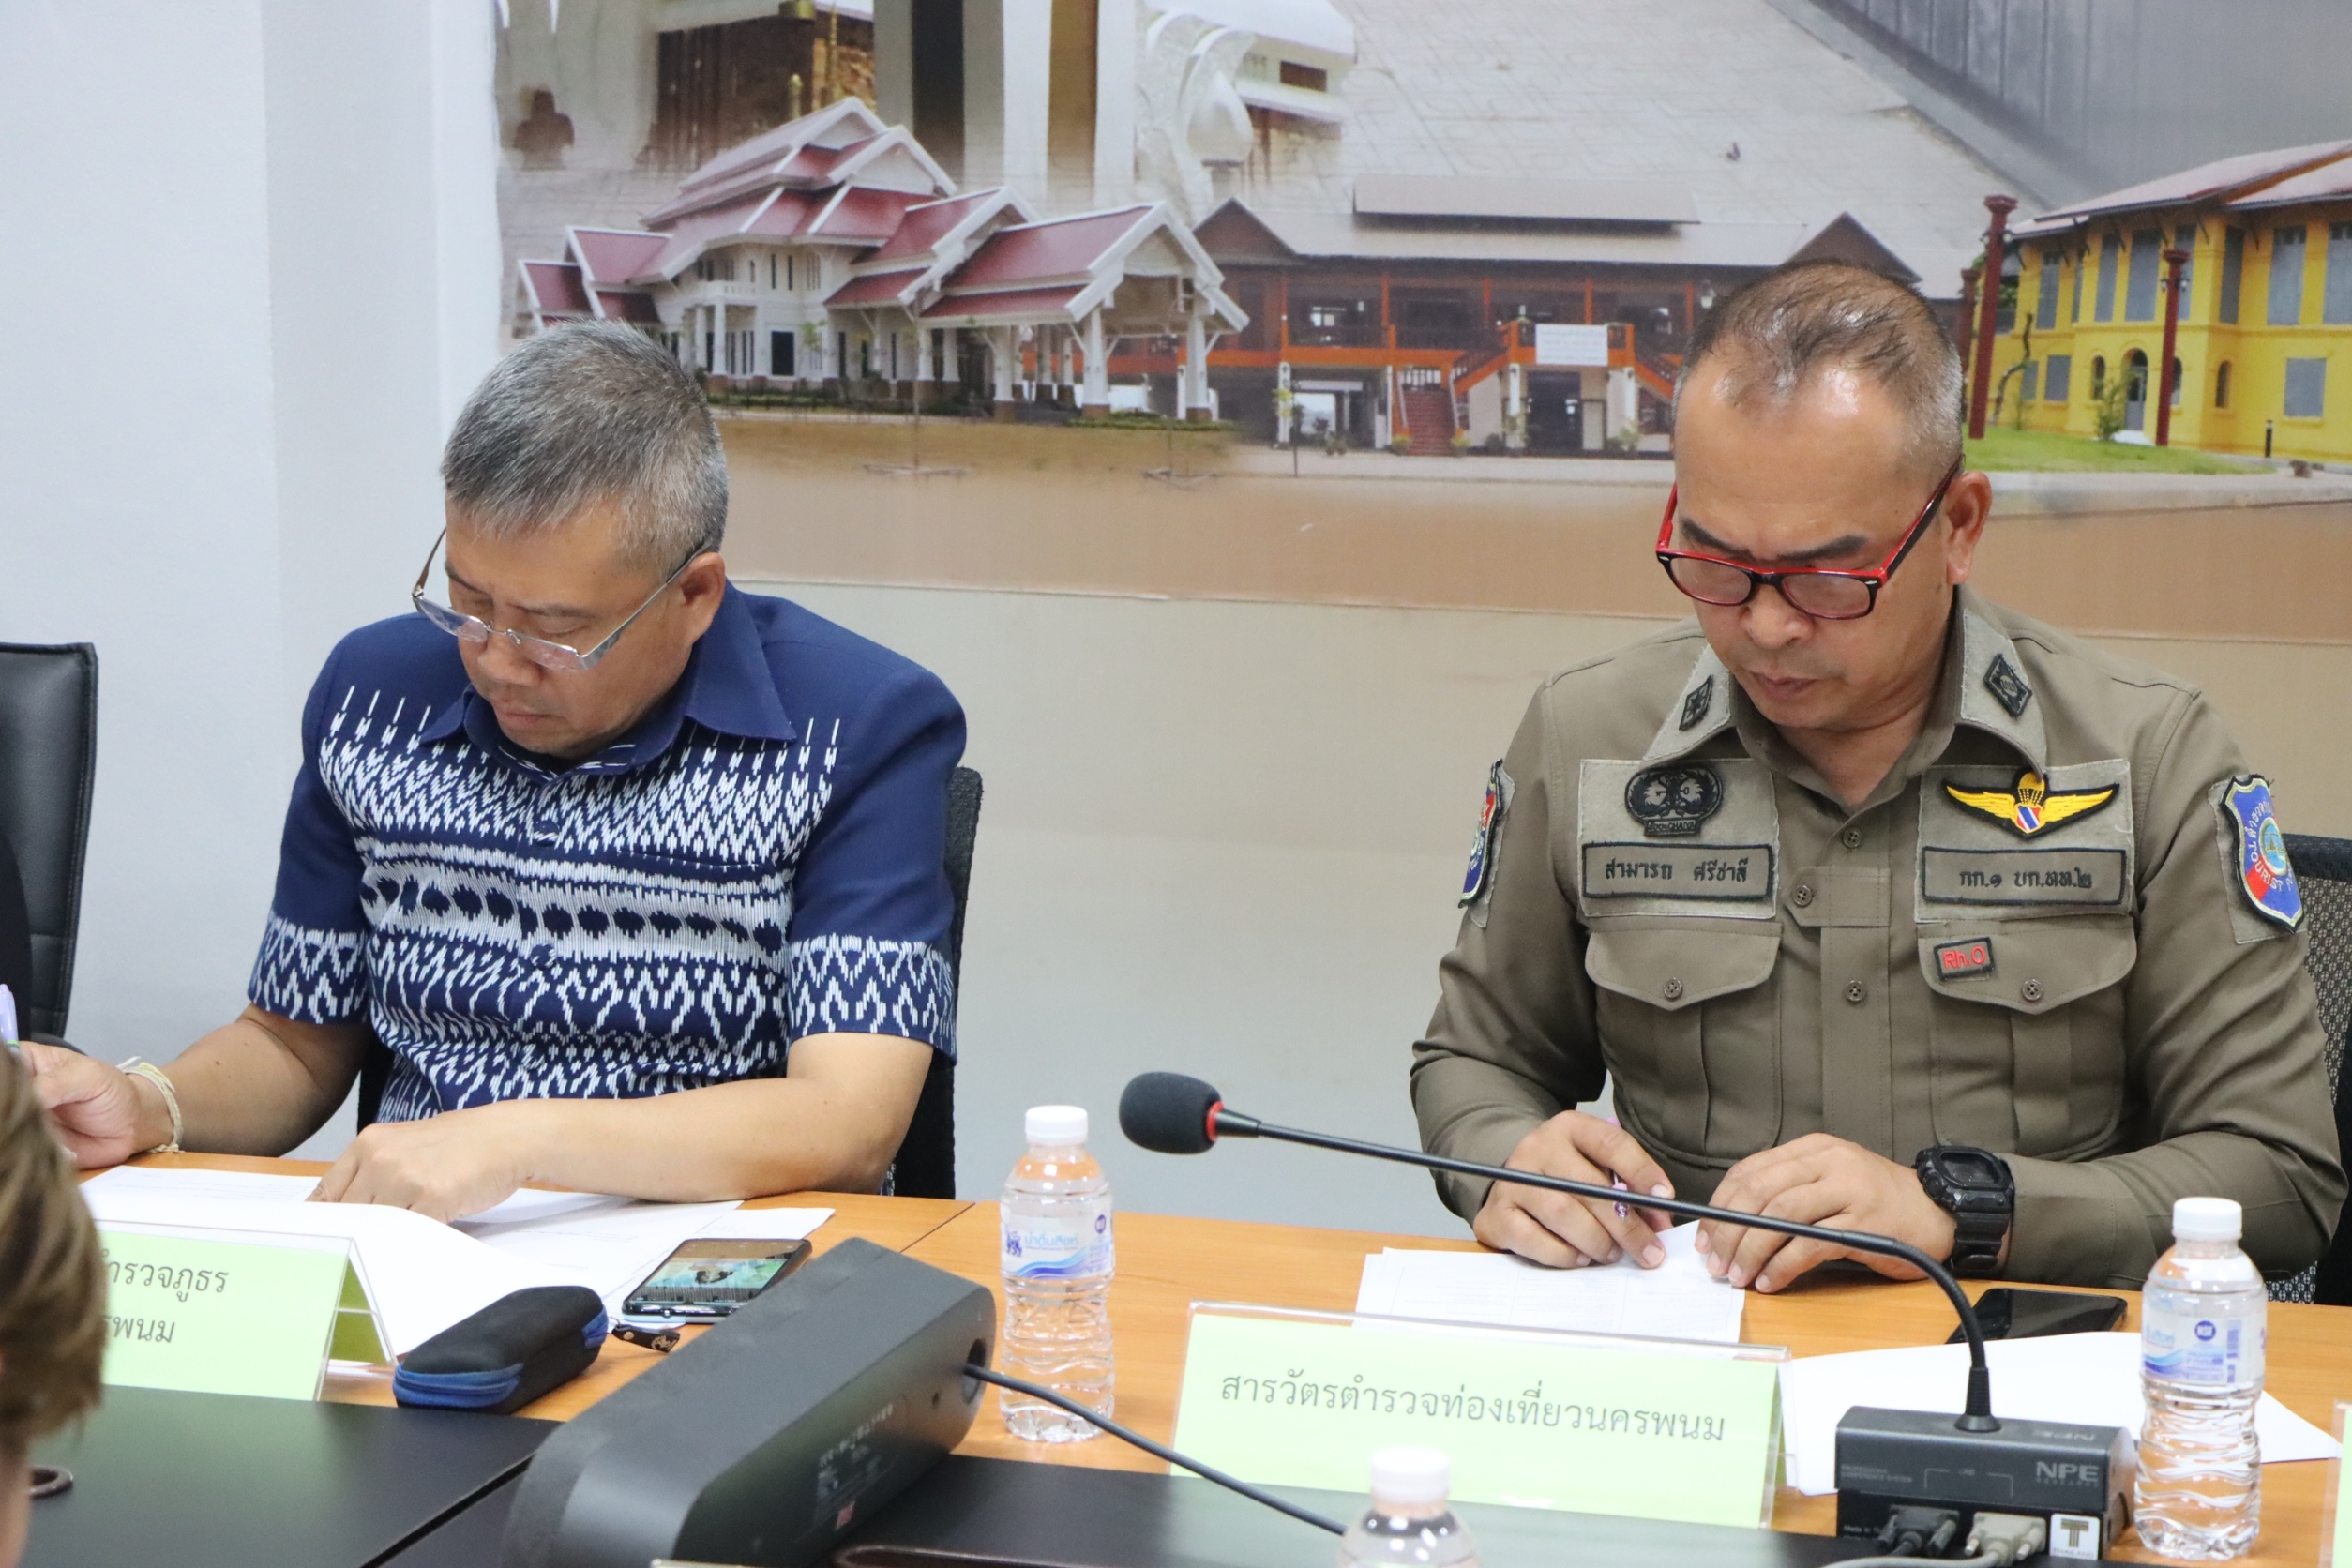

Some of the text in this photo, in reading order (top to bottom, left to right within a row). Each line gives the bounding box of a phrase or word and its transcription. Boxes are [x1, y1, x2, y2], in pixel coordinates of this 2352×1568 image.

[1605, 857, 1674, 881] สามารถ
[2248, 843, 2284, 892] TOURIST
[101, 1248, 230, 1303] ำรวจภูธร
[105, 1315, 176, 1344] พนม
[1221, 1368, 1726, 1441] สารวัตรตำรวจท่องเที่ยวนครพนม
[2036, 1460, 2100, 1483] NPE
